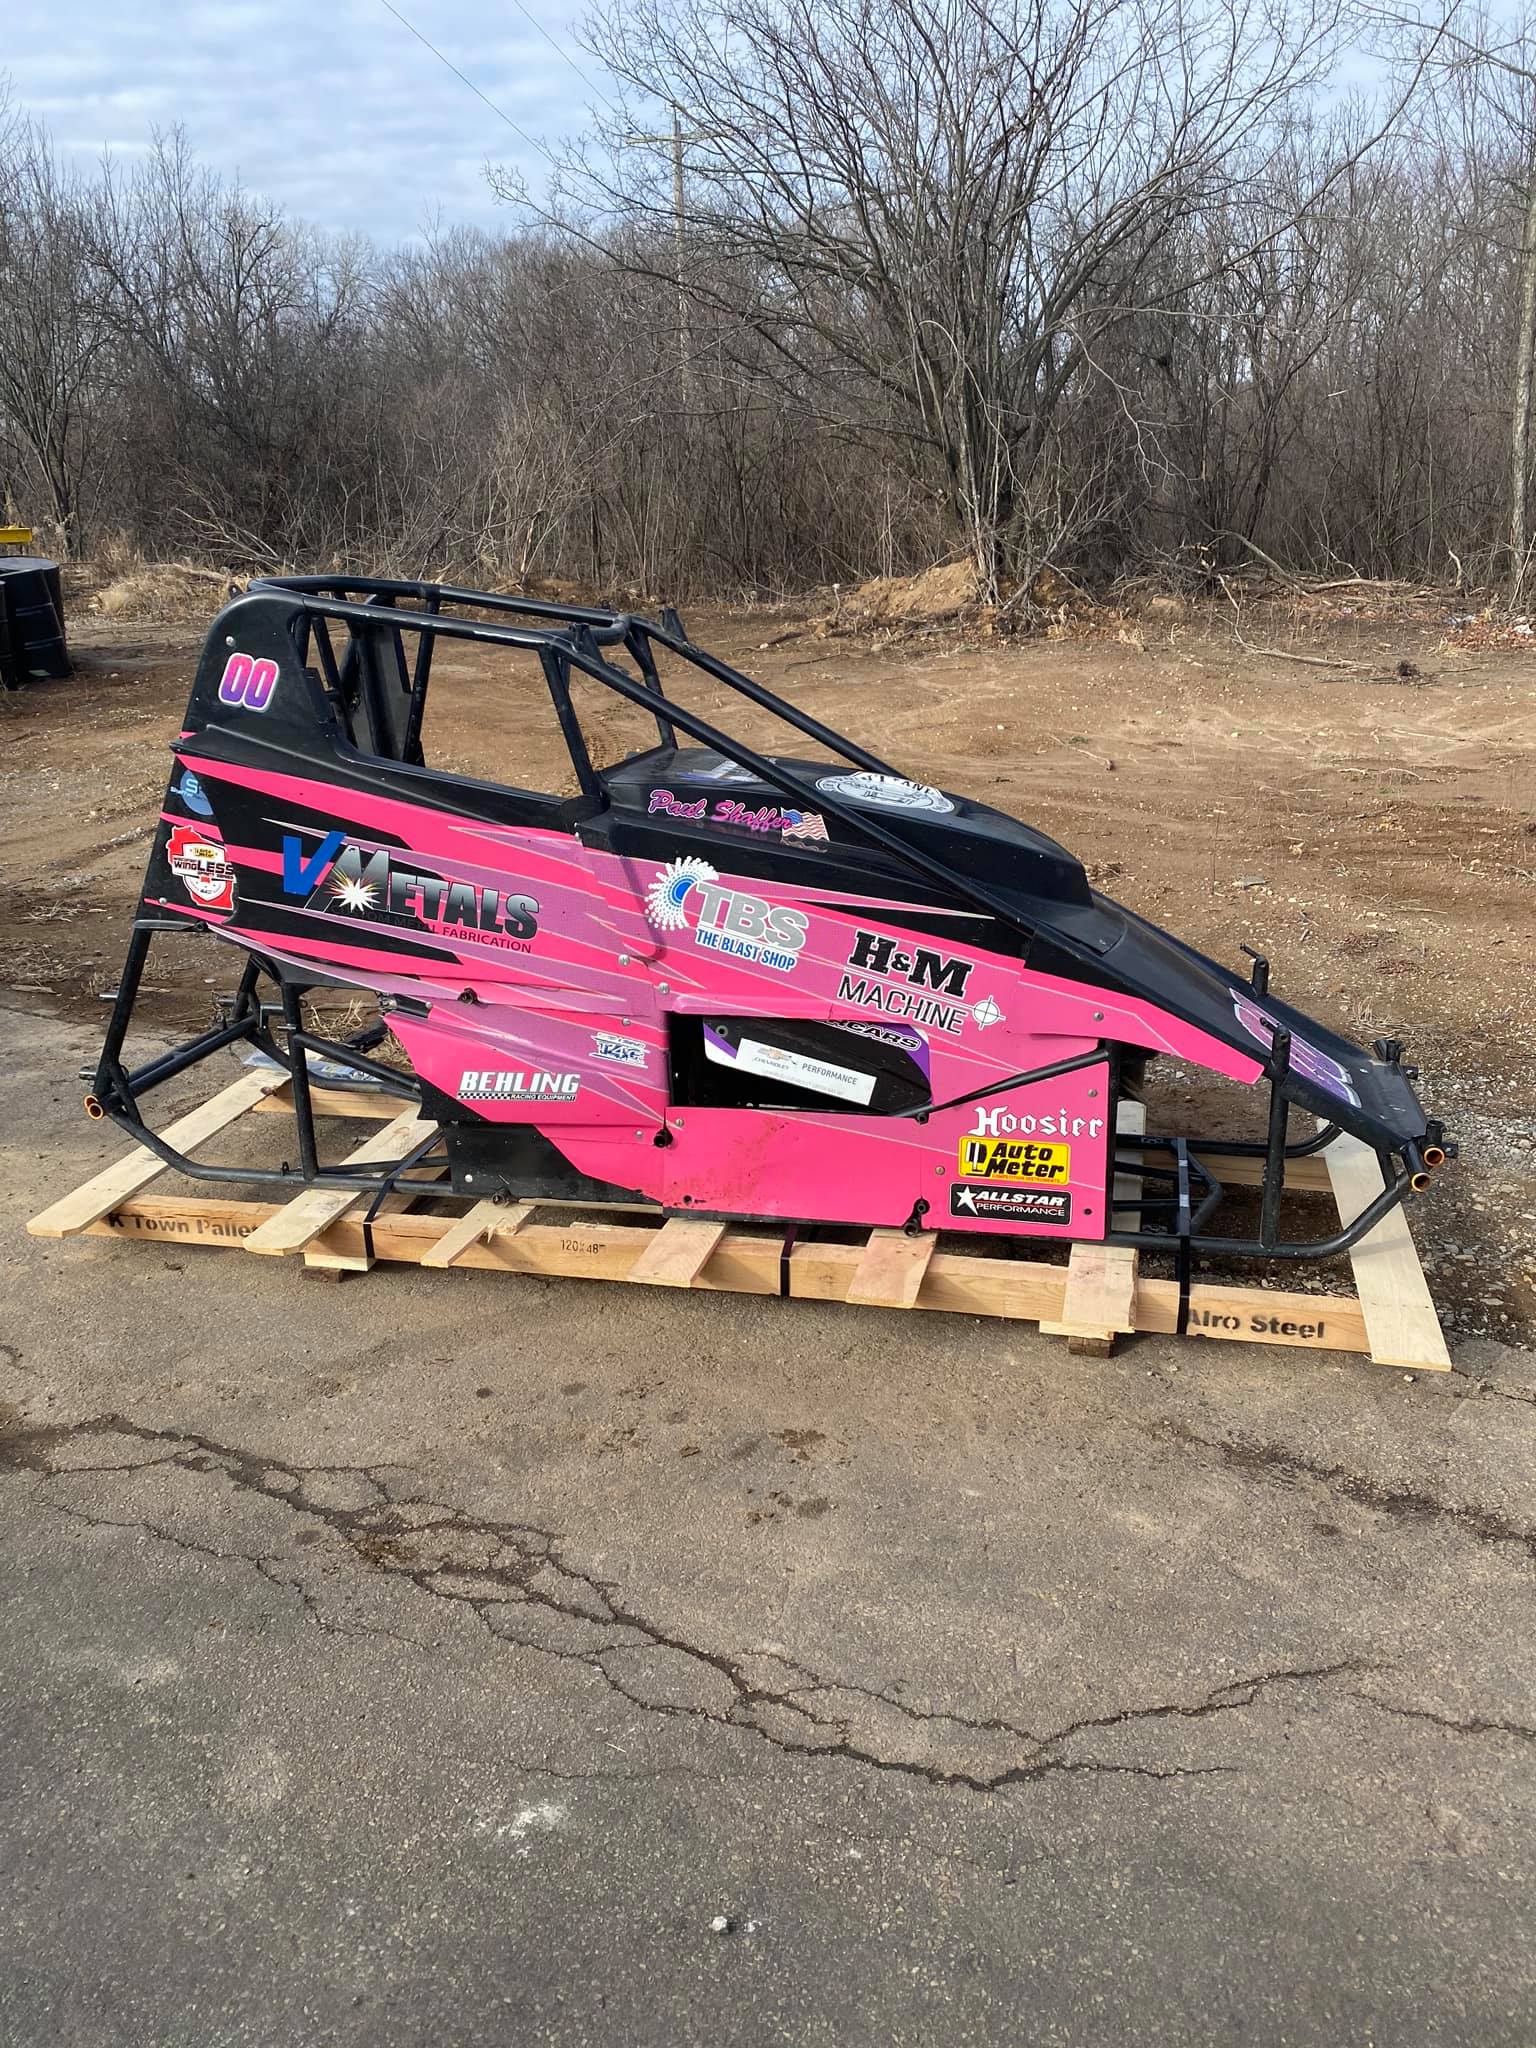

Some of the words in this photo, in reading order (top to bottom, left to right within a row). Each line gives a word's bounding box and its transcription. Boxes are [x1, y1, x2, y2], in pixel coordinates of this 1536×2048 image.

[219, 652, 279, 713] 00
[649, 790, 707, 819] Paul
[711, 800, 794, 832] Shaffer
[697, 881, 809, 951] TBS
[443, 926, 532, 953] FABRICATION
[696, 928, 719, 948] THE
[720, 933, 761, 961] BLAST
[760, 949, 797, 971] SHOP
[849, 930, 973, 997] H&M
[838, 974, 968, 1034] MACHINE
[460, 1072, 580, 1093] BEHLING
[801, 1062, 859, 1086] PERFORMANCE
[511, 1093, 536, 1101] RACING
[537, 1094, 576, 1102] EQUIPMENT
[968, 1106, 1104, 1138] Hoosier
[992, 1142, 1053, 1161] Auto
[986, 1158, 1064, 1178] Meter
[975, 1191, 1066, 1206] ALLSTAR
[976, 1203, 1065, 1217] PERFORMANCE
[131, 1216, 190, 1233] Town
[1250, 1315, 1325, 1338] Steel
